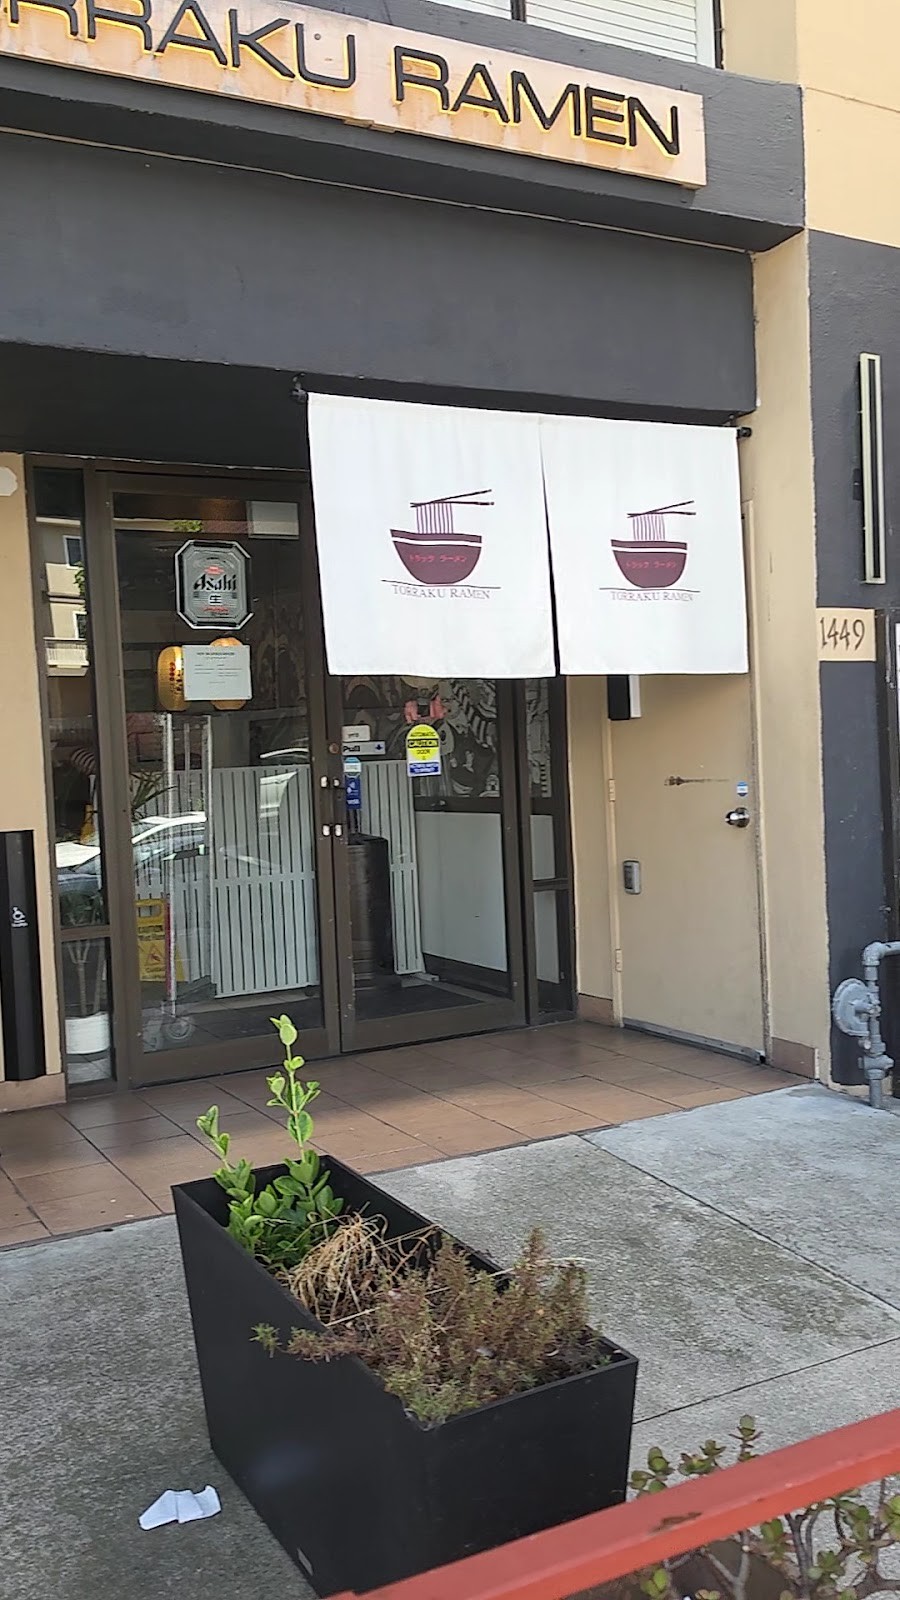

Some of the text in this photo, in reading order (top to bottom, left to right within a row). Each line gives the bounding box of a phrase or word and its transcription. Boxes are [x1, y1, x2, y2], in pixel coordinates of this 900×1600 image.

[391, 45, 681, 158] RAMEN
[193, 573, 237, 591] Asahi
[392, 584, 490, 600] TORRAKU RAMEN
[662, 591, 694, 602] RAMEN
[820, 617, 865, 650] 1449
